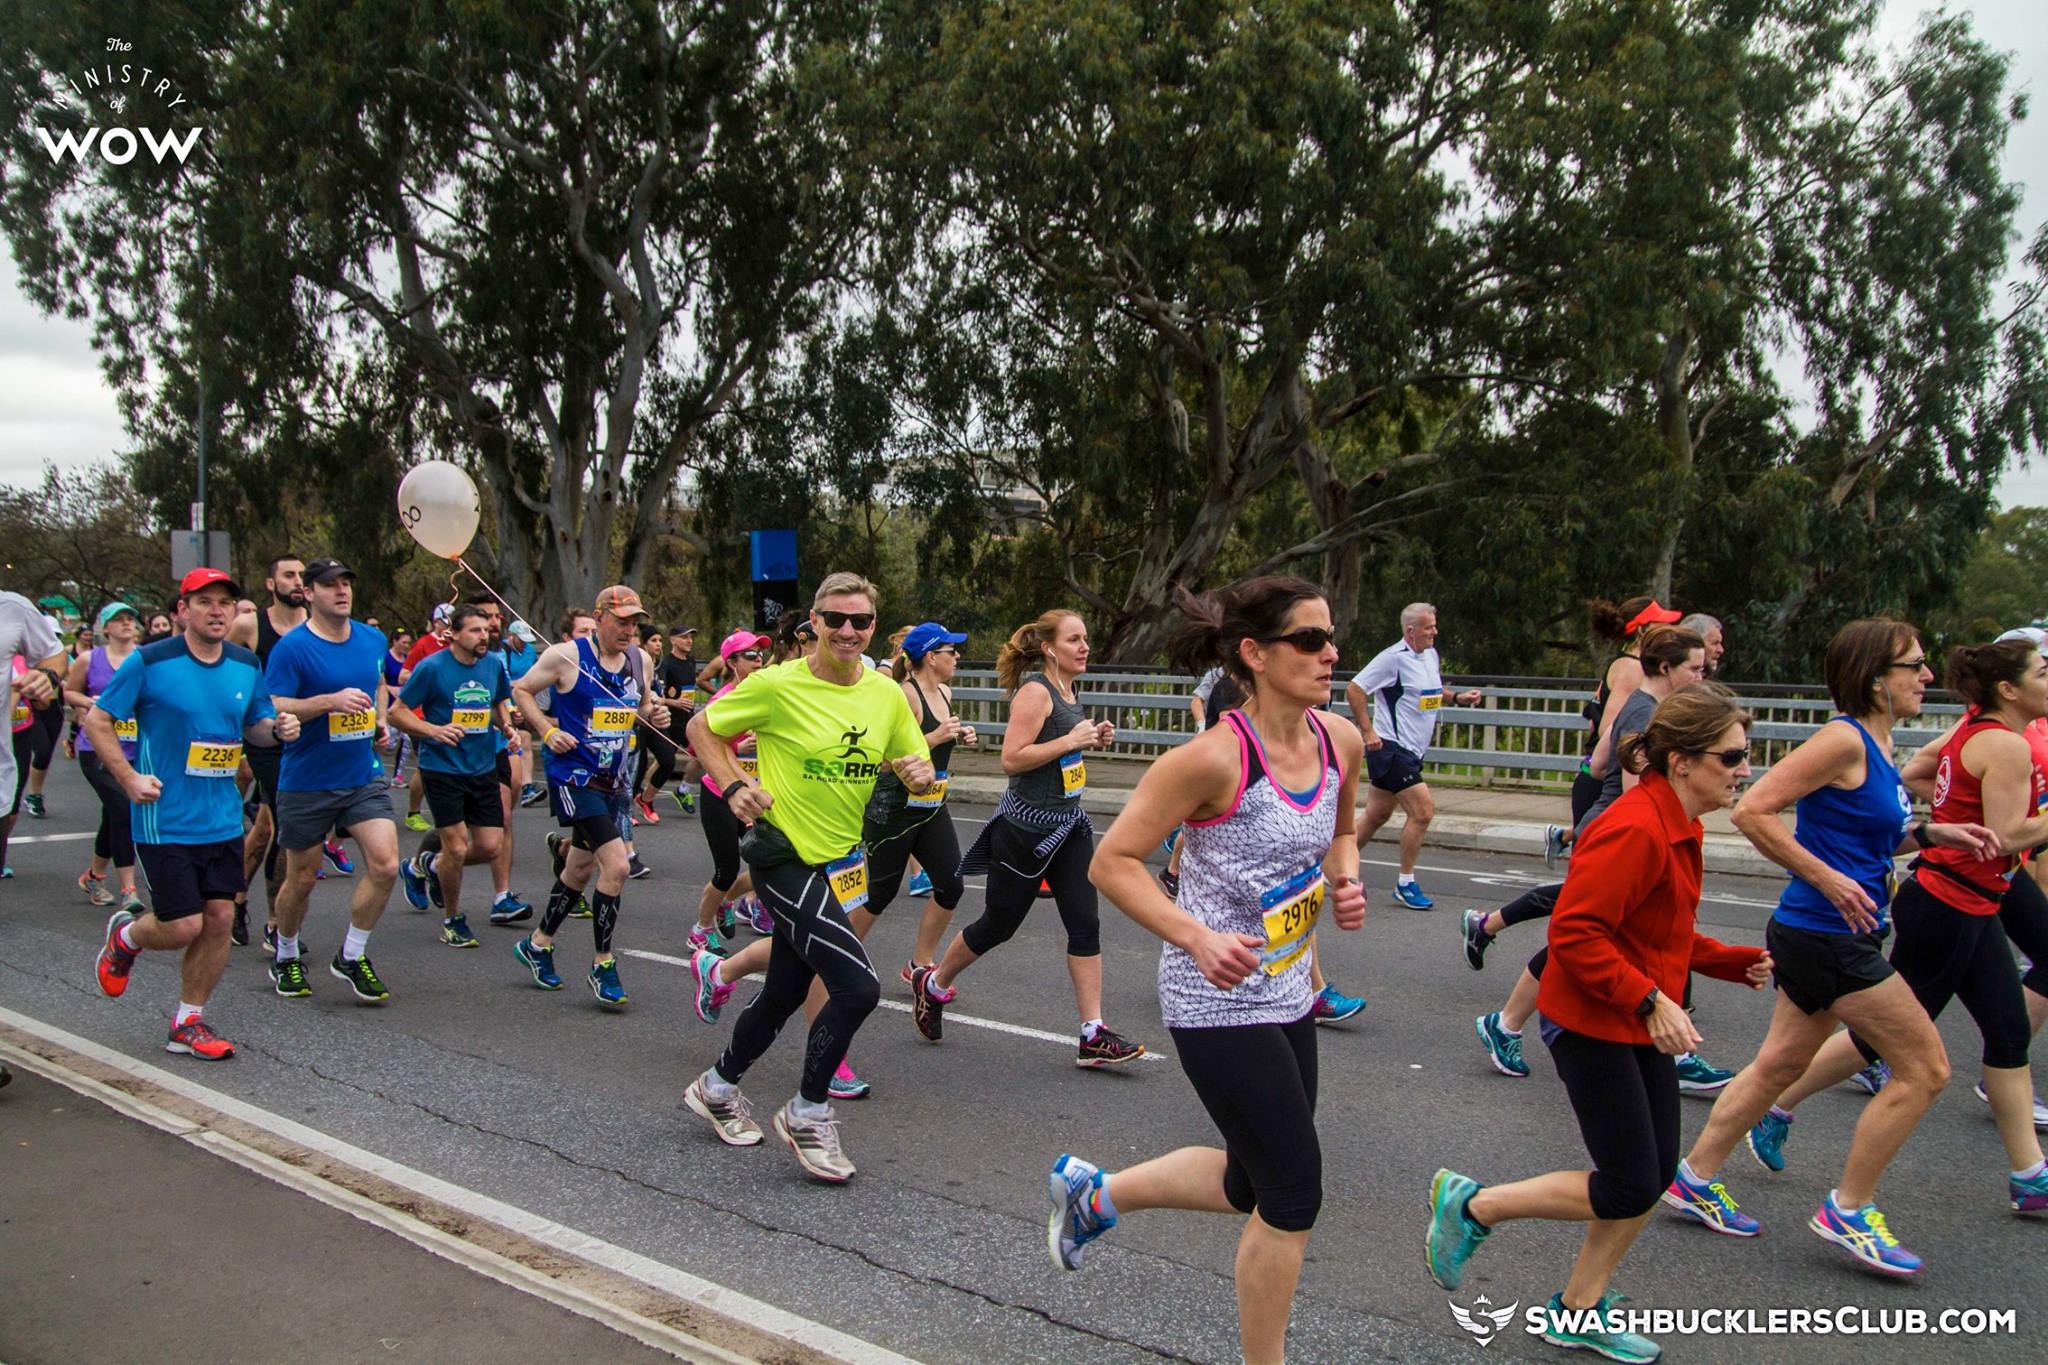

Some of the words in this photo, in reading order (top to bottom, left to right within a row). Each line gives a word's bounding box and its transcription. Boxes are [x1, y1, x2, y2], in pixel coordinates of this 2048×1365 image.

[341, 712, 369, 727] 2328
[462, 712, 485, 722] 2799
[604, 711, 631, 724] 2887
[113, 720, 135, 731] 835
[202, 748, 234, 762] 2236
[837, 869, 862, 894] 2852
[1282, 892, 1319, 934] 2976
